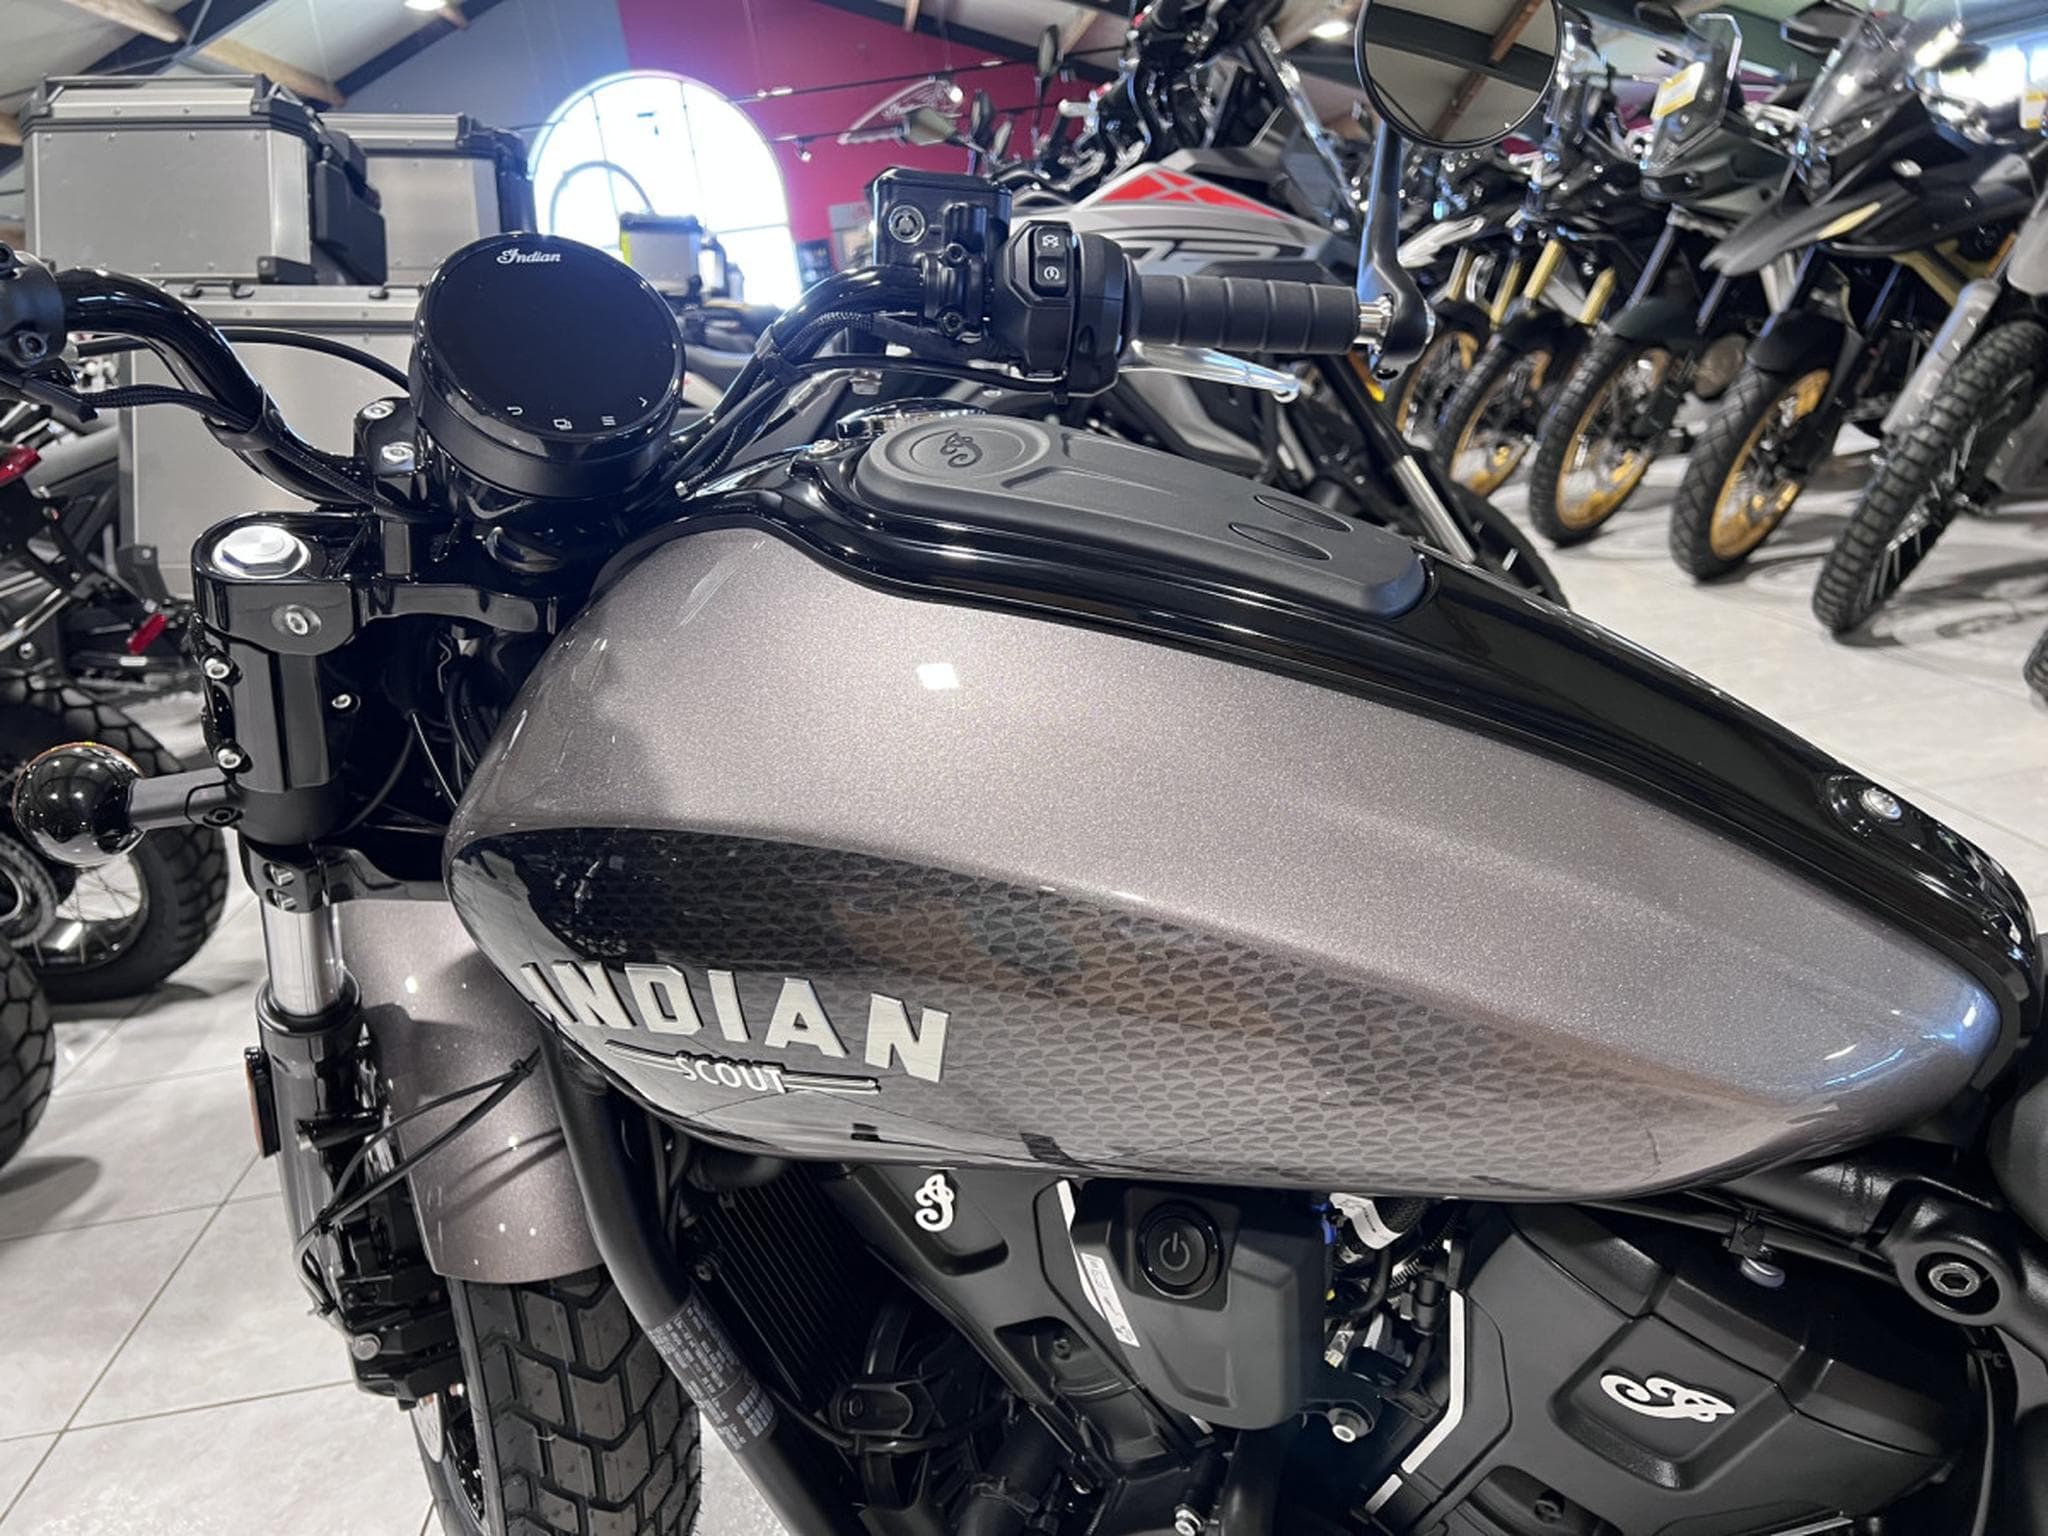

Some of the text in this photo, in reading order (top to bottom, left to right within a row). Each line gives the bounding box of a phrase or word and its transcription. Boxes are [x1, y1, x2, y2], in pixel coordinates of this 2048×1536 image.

[496, 248, 561, 264] Indian
[520, 960, 950, 1083] INDIAN
[675, 1053, 786, 1094] SCOUT
